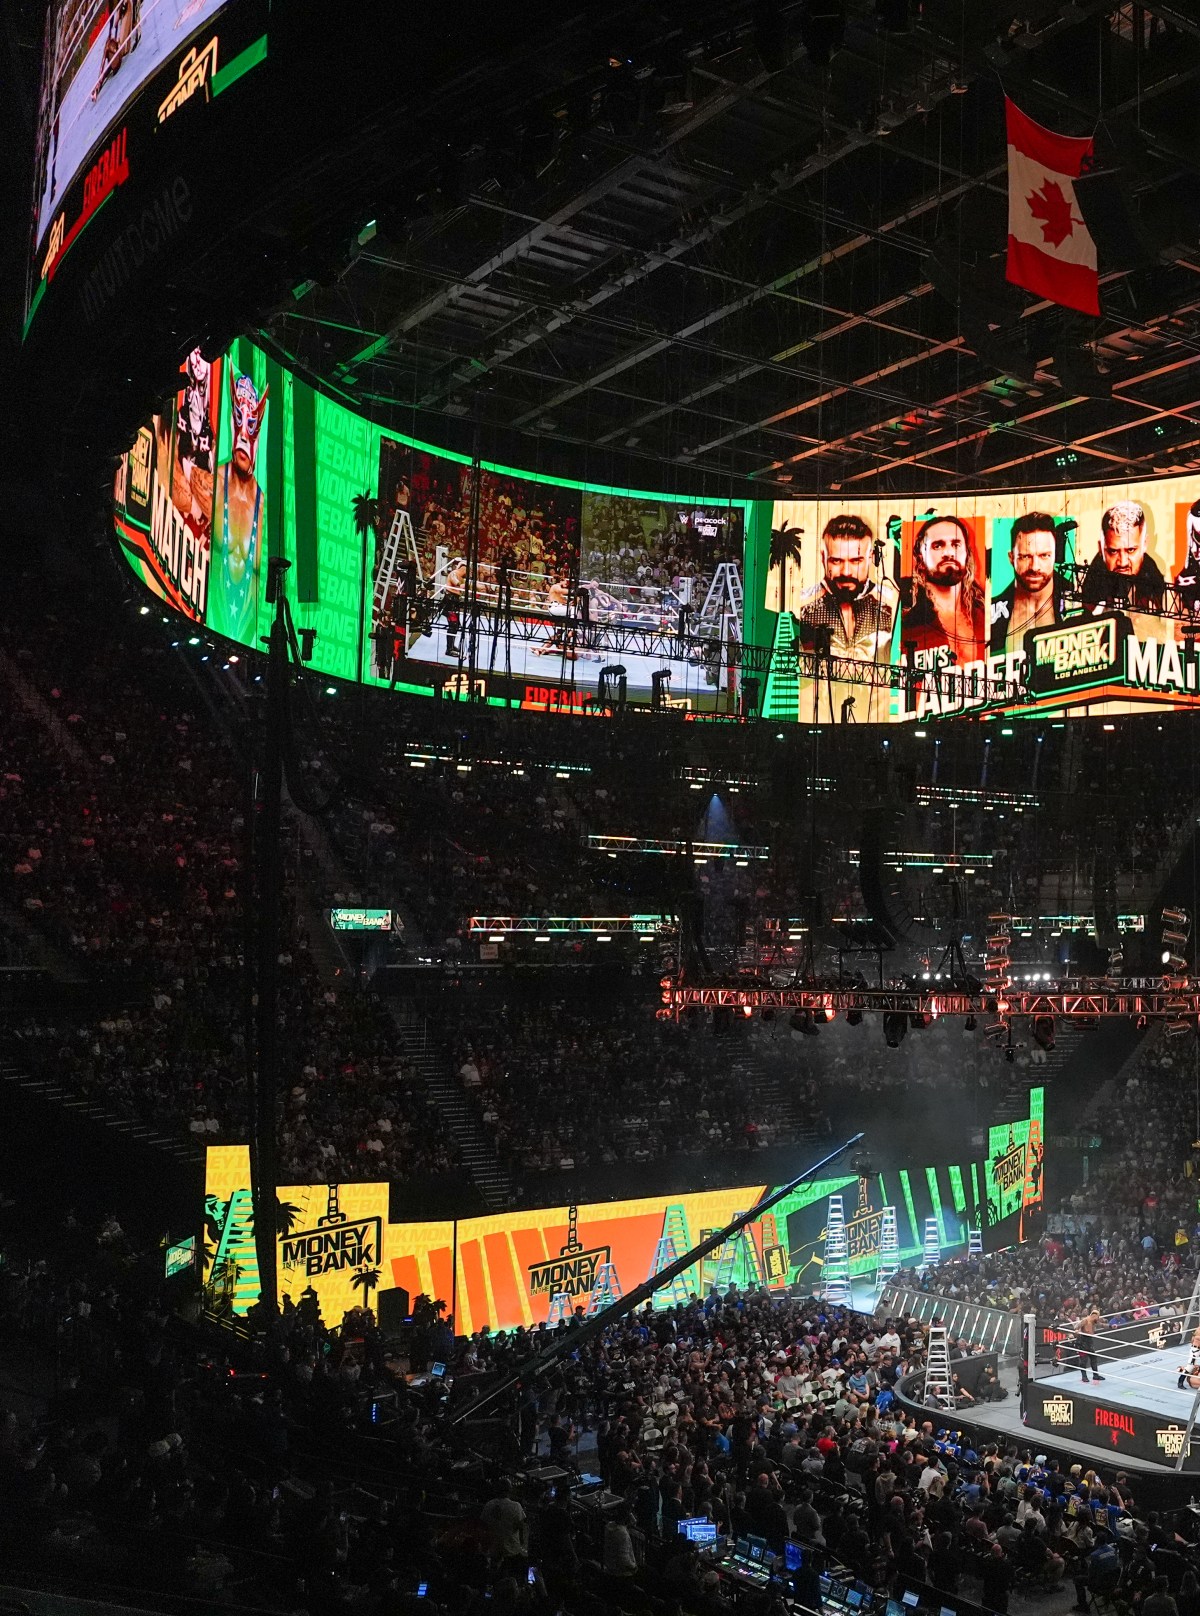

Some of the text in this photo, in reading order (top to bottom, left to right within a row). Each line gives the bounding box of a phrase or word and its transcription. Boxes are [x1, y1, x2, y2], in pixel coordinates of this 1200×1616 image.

[694, 516, 727, 525] peacock
[150, 468, 206, 613] MATCH
[1036, 625, 1105, 658] MONEY
[1054, 643, 1110, 673] BANK
[1055, 664, 1108, 680] LOS ANGELES
[994, 1149, 1023, 1183] MONEY
[1003, 1162, 1025, 1192] BANK
[283, 1225, 370, 1263] MONEY
[291, 1258, 307, 1267] THE
[306, 1243, 375, 1278] BANK
[530, 1255, 601, 1289] MONEY
[538, 1285, 550, 1294] THE
[1043, 1403, 1070, 1417] MONEY
[1050, 1412, 1071, 1423] BANK
[1095, 1408, 1135, 1436] FIREBALL
[1156, 1433, 1186, 1447] MONEY
[1164, 1442, 1184, 1454] BAN
